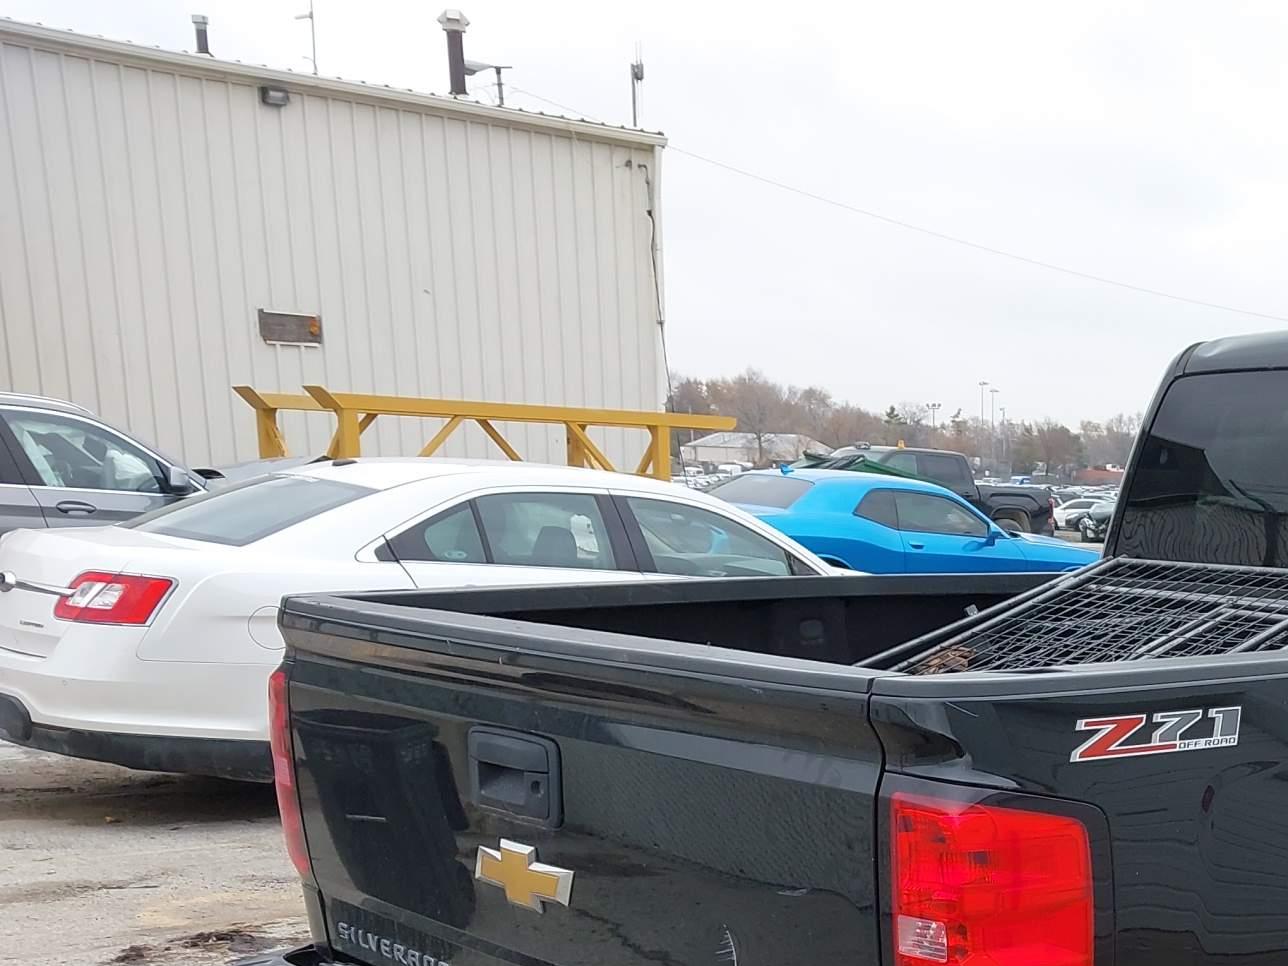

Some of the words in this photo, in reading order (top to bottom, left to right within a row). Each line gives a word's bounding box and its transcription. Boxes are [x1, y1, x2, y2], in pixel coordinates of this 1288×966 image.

[1070, 706, 1241, 762] Z71
[1178, 740, 1204, 750] OFF
[1204, 736, 1236, 747] ROAD
